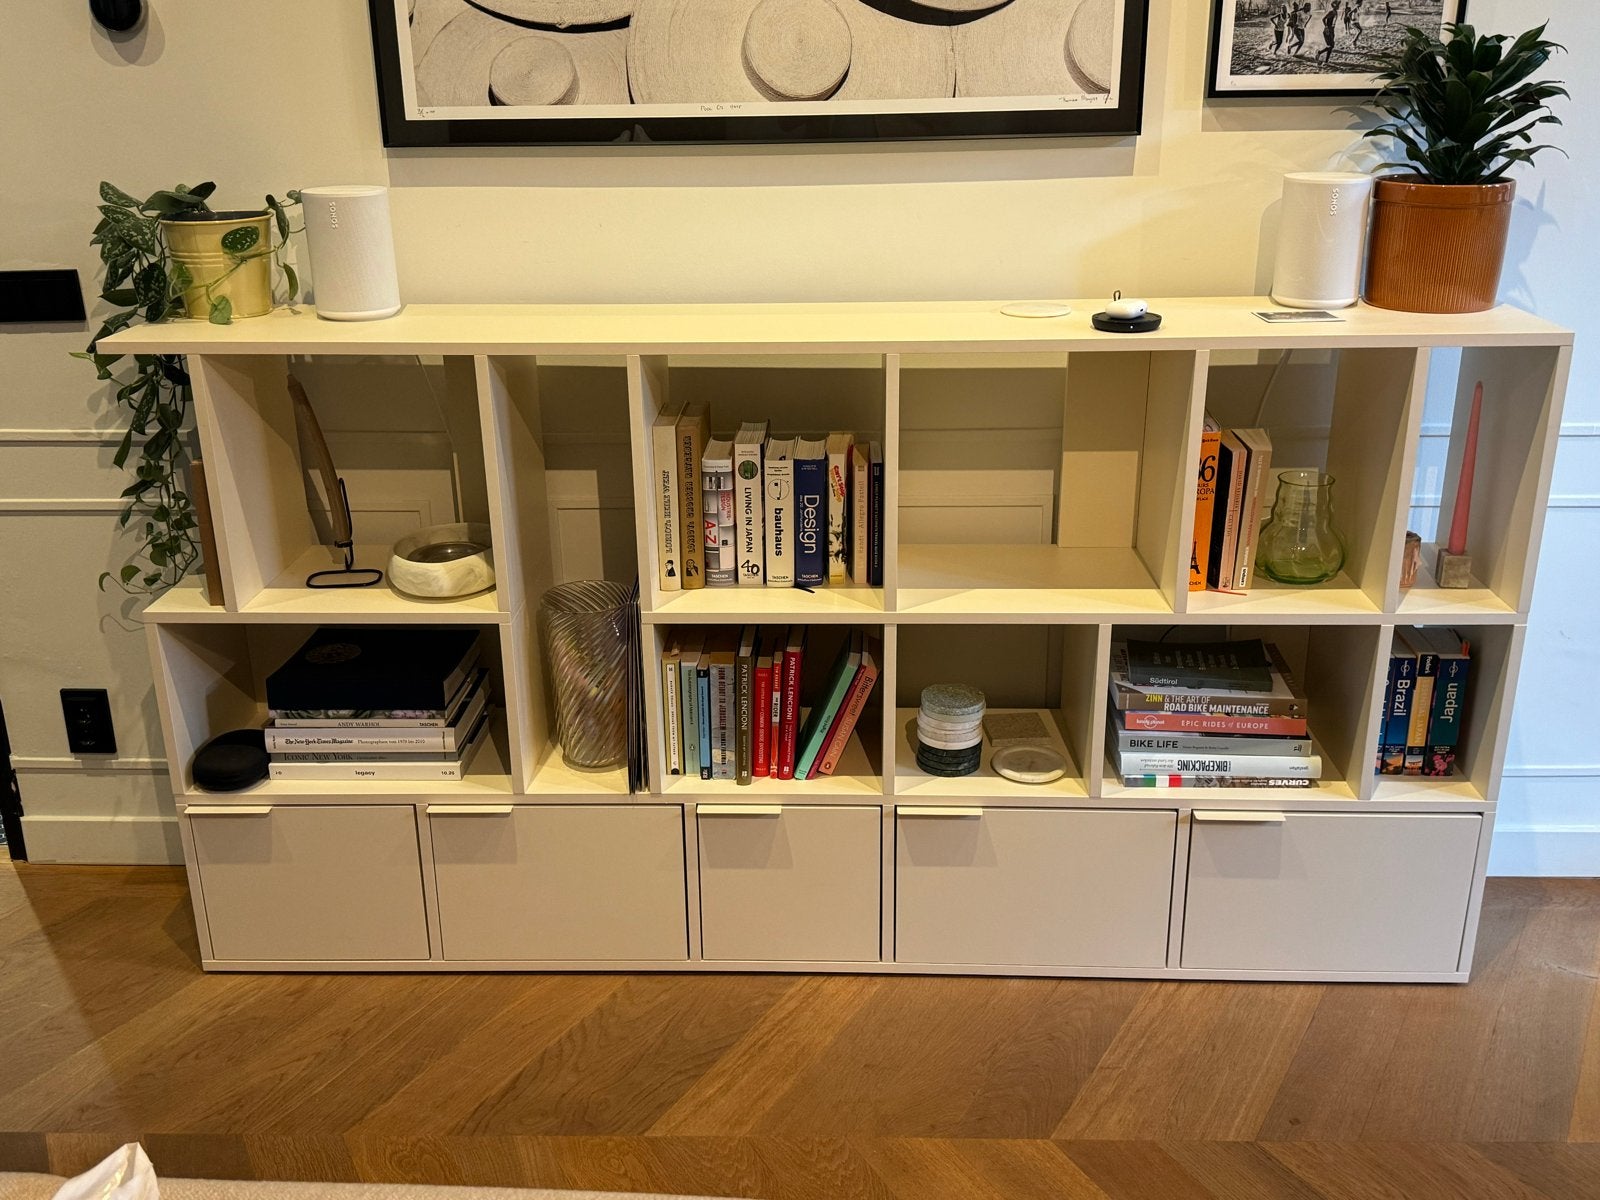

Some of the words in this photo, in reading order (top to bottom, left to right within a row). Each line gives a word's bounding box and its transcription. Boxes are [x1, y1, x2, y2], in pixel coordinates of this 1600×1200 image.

[1330, 187, 1339, 216] SONOS
[329, 201, 338, 229] SONOS
[744, 487, 752, 515] LIVING
[705, 520, 717, 544] A-Z
[745, 517, 752, 526] IN
[774, 508, 783, 556] bauhaus
[799, 494, 820, 554] Design
[741, 560, 760, 574] 40
[788, 657, 796, 685] PATRICK
[1425, 656, 1433, 674] Fodor's
[1150, 677, 1178, 685] Südtirol
[786, 687, 794, 720] LENCIONI
[850, 675, 874, 717] Bittersweet
[1146, 694, 1163, 702] ZINN
[1164, 695, 1170, 703] &
[1172, 695, 1184, 703] THE
[1186, 695, 1200, 704] ART
[1201, 696, 1211, 704] OF
[1394, 680, 1410, 716] Brazil
[1440, 682, 1458, 723] Japan
[1164, 703, 1186, 711] ROAD
[1188, 704, 1208, 712] BIKE
[1209, 704, 1269, 714] MAINTENANCE
[1202, 720, 1226, 728] RIDES
[1236, 721, 1269, 730] EUROPE
[305, 738, 317, 746] York
[1130, 740, 1154, 748] BIKE
[1157, 740, 1178, 749] LIFE
[1177, 760, 1228, 772] BIKEPACKING
